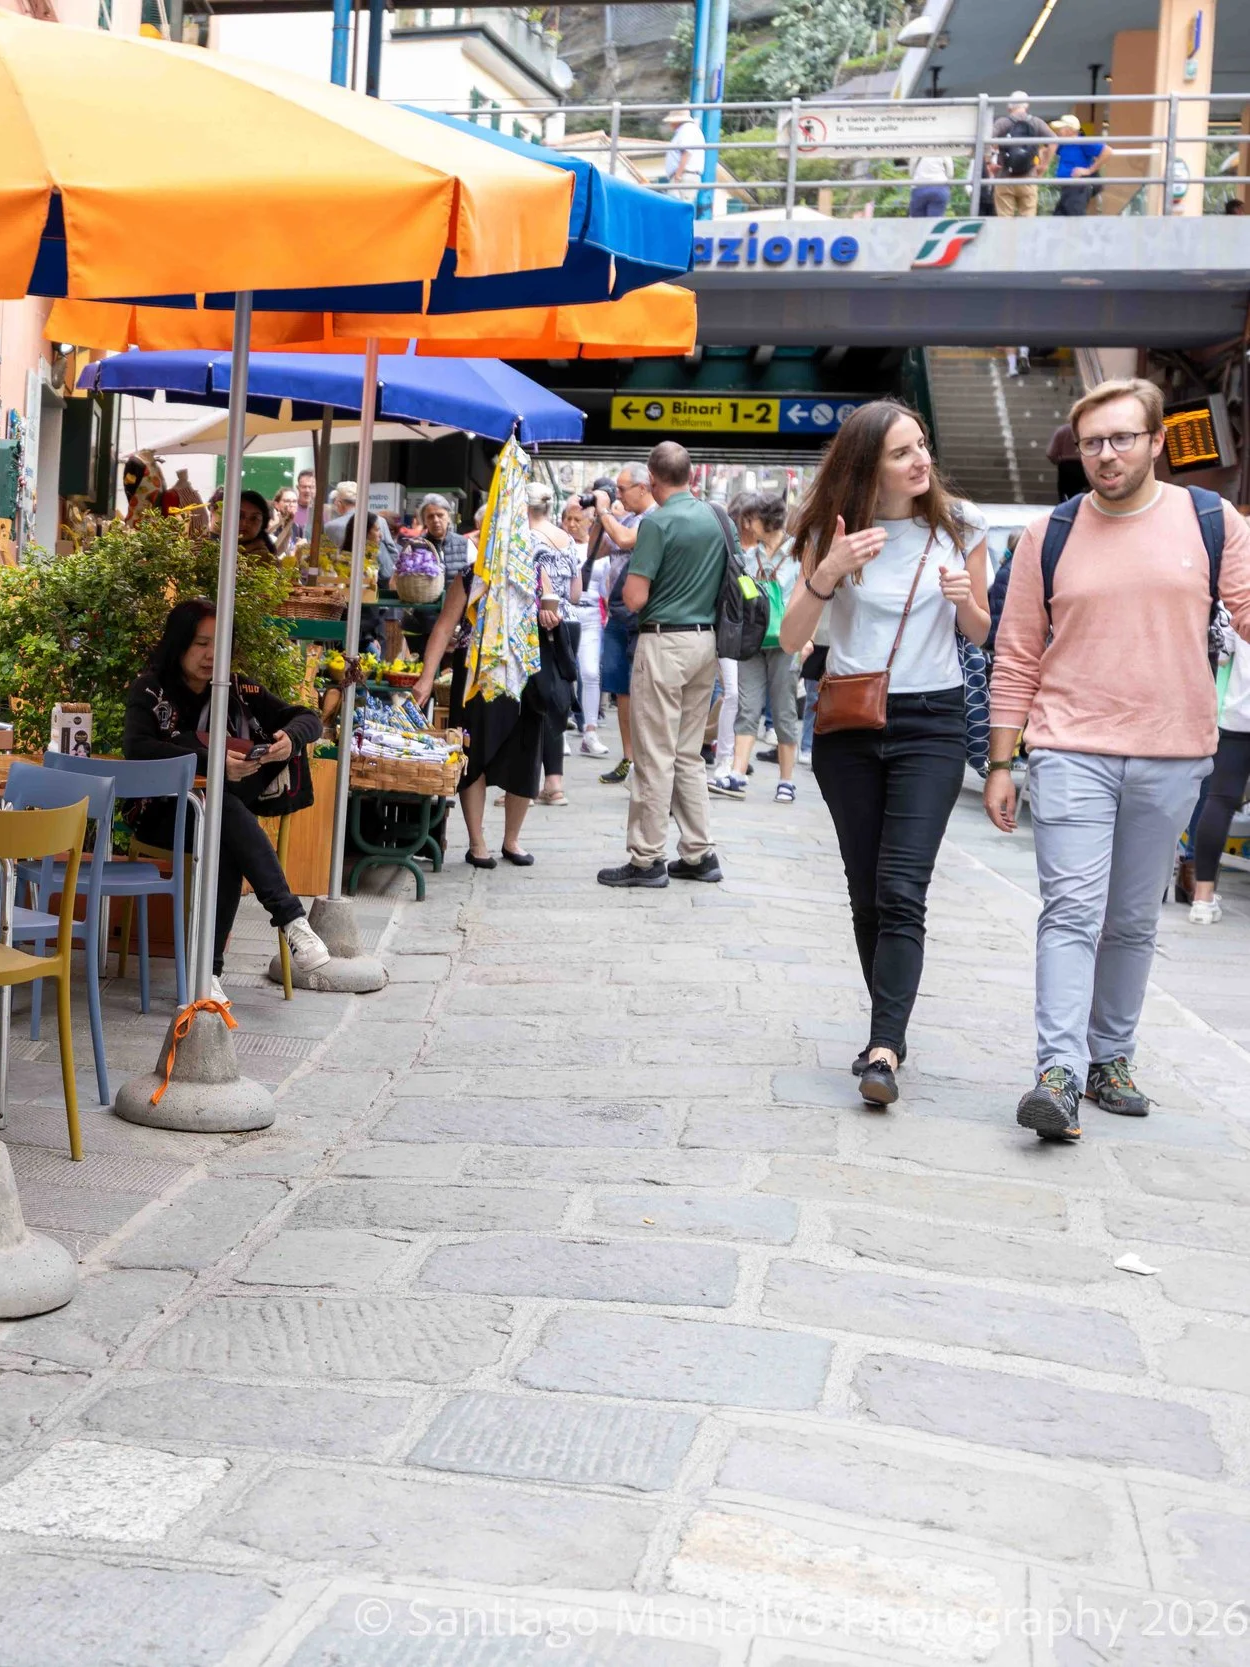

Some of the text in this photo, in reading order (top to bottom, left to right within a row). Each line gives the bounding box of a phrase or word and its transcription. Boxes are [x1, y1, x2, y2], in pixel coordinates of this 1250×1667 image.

[672, 401, 773, 424] Binari 1-2
[670, 417, 713, 428] Platforms
